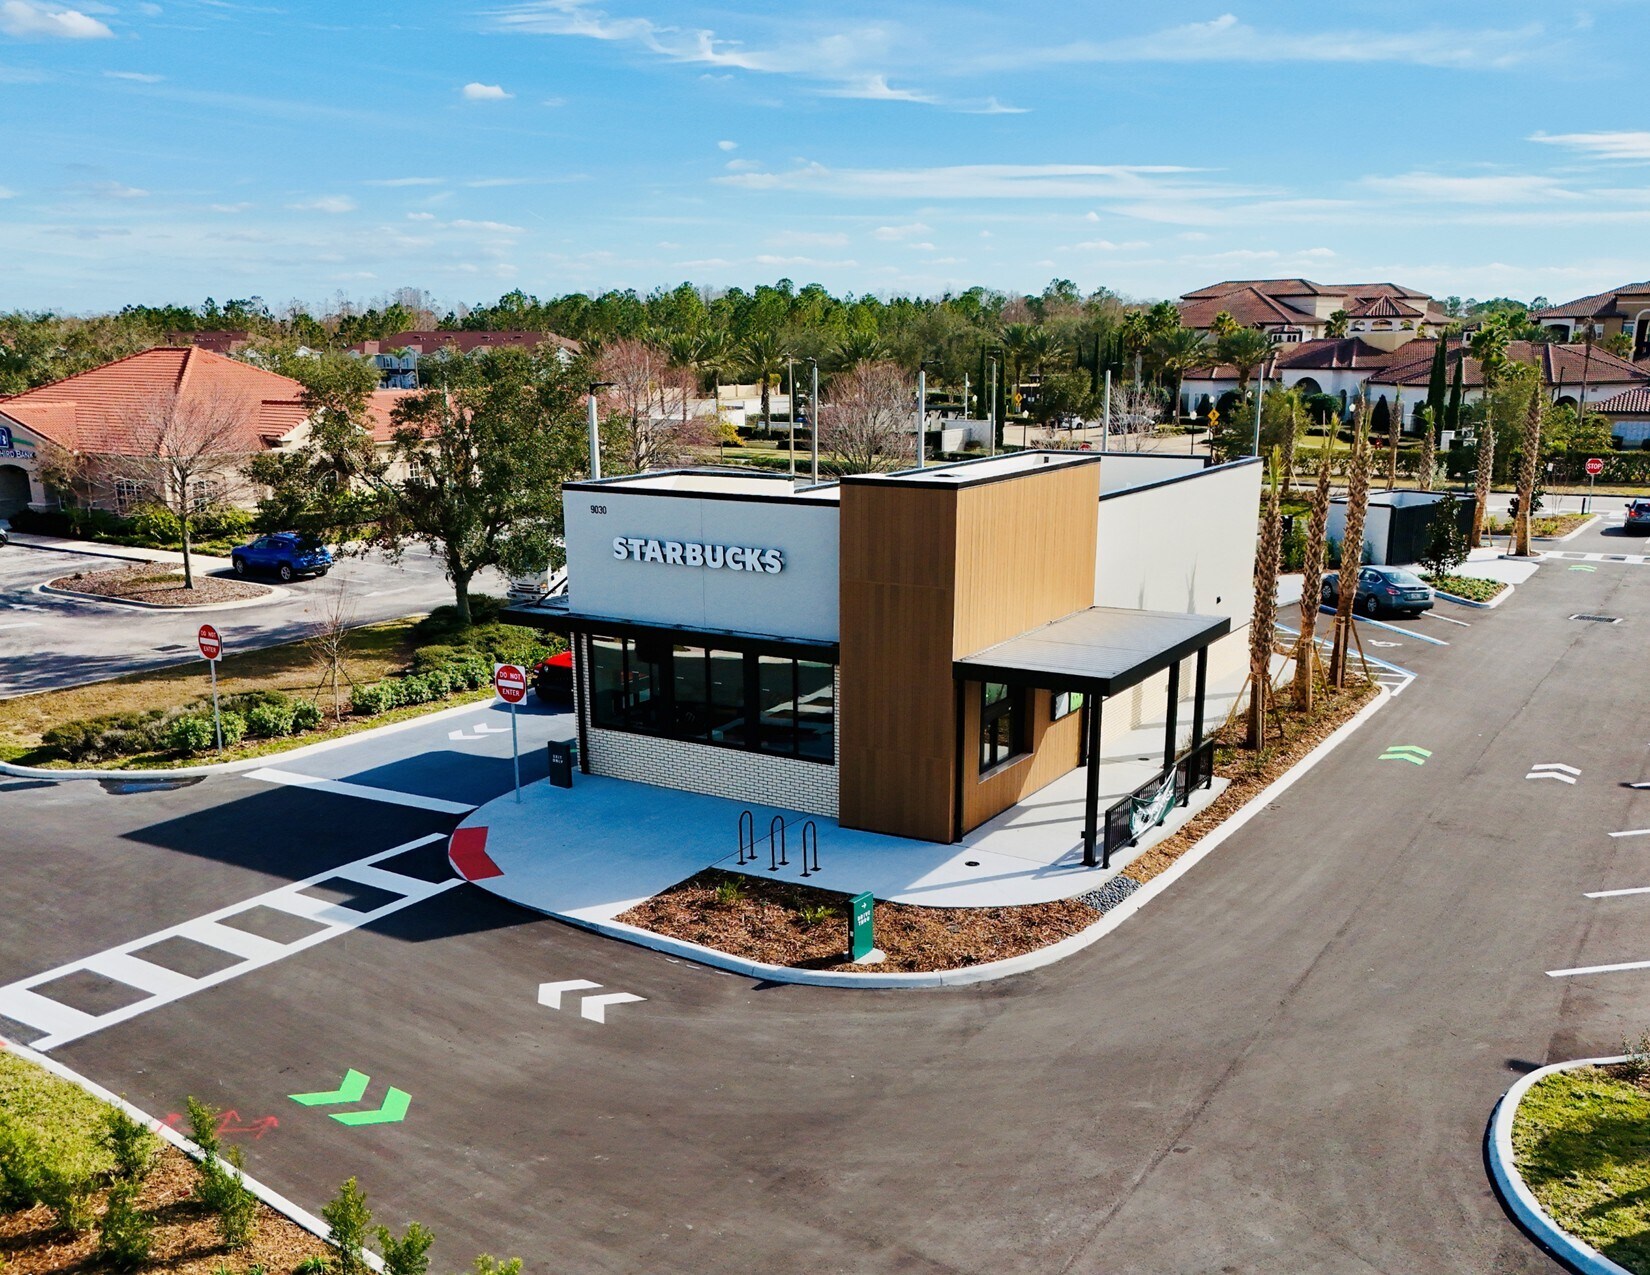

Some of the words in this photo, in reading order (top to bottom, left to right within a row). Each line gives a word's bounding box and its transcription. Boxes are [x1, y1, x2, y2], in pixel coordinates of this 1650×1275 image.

[590, 505, 607, 515] 9030
[612, 536, 783, 575] STARBUCKS
[499, 671, 508, 679] DO
[510, 672, 521, 681] NOT
[502, 688, 520, 697] ENTER
[857, 910, 871, 921] DRIVE
